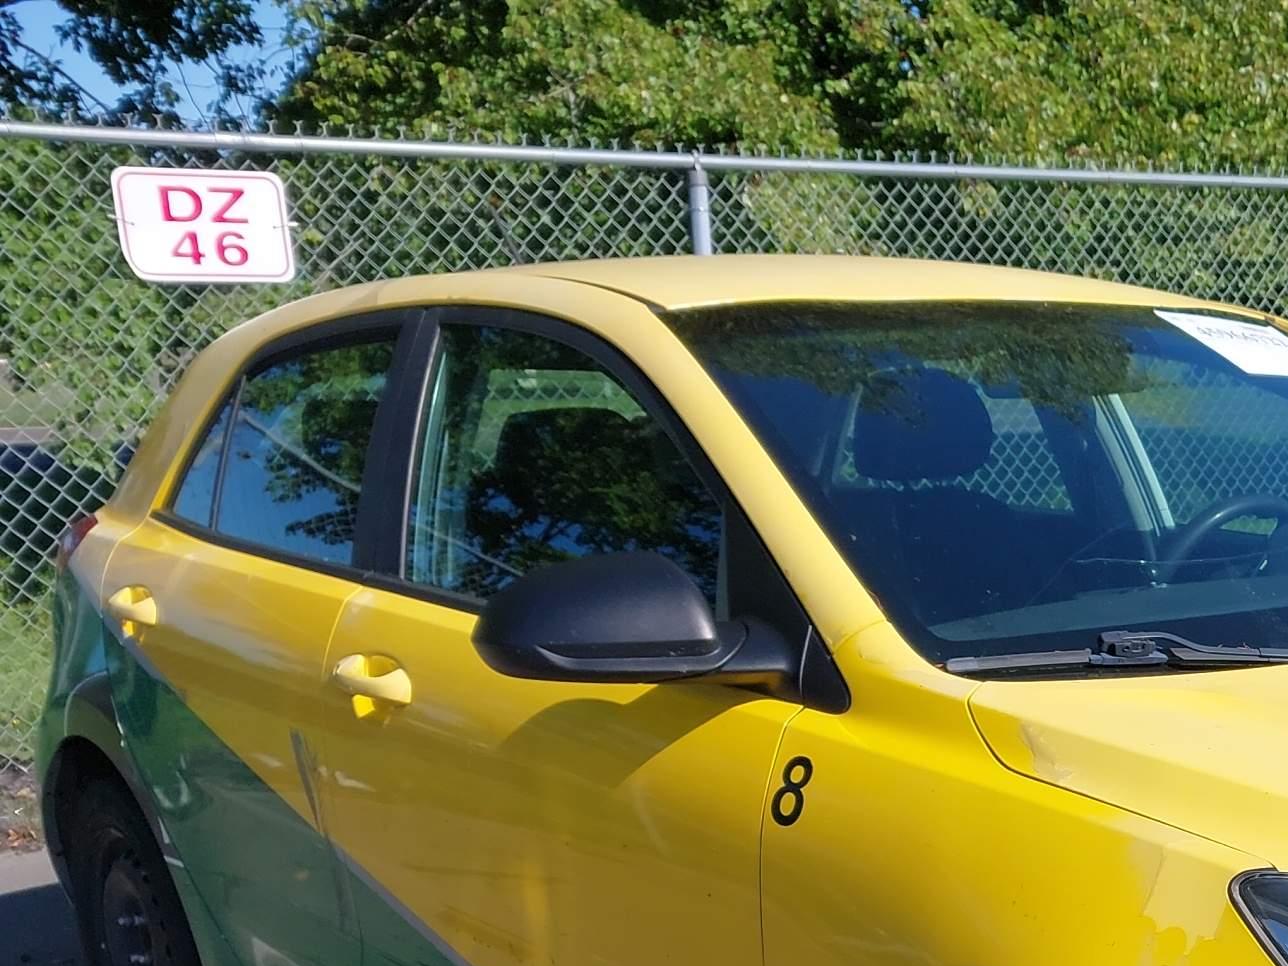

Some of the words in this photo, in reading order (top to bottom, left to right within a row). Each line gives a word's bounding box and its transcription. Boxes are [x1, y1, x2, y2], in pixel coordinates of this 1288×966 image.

[158, 185, 249, 223] DZ
[171, 231, 249, 266] 46
[770, 755, 814, 827] 8
